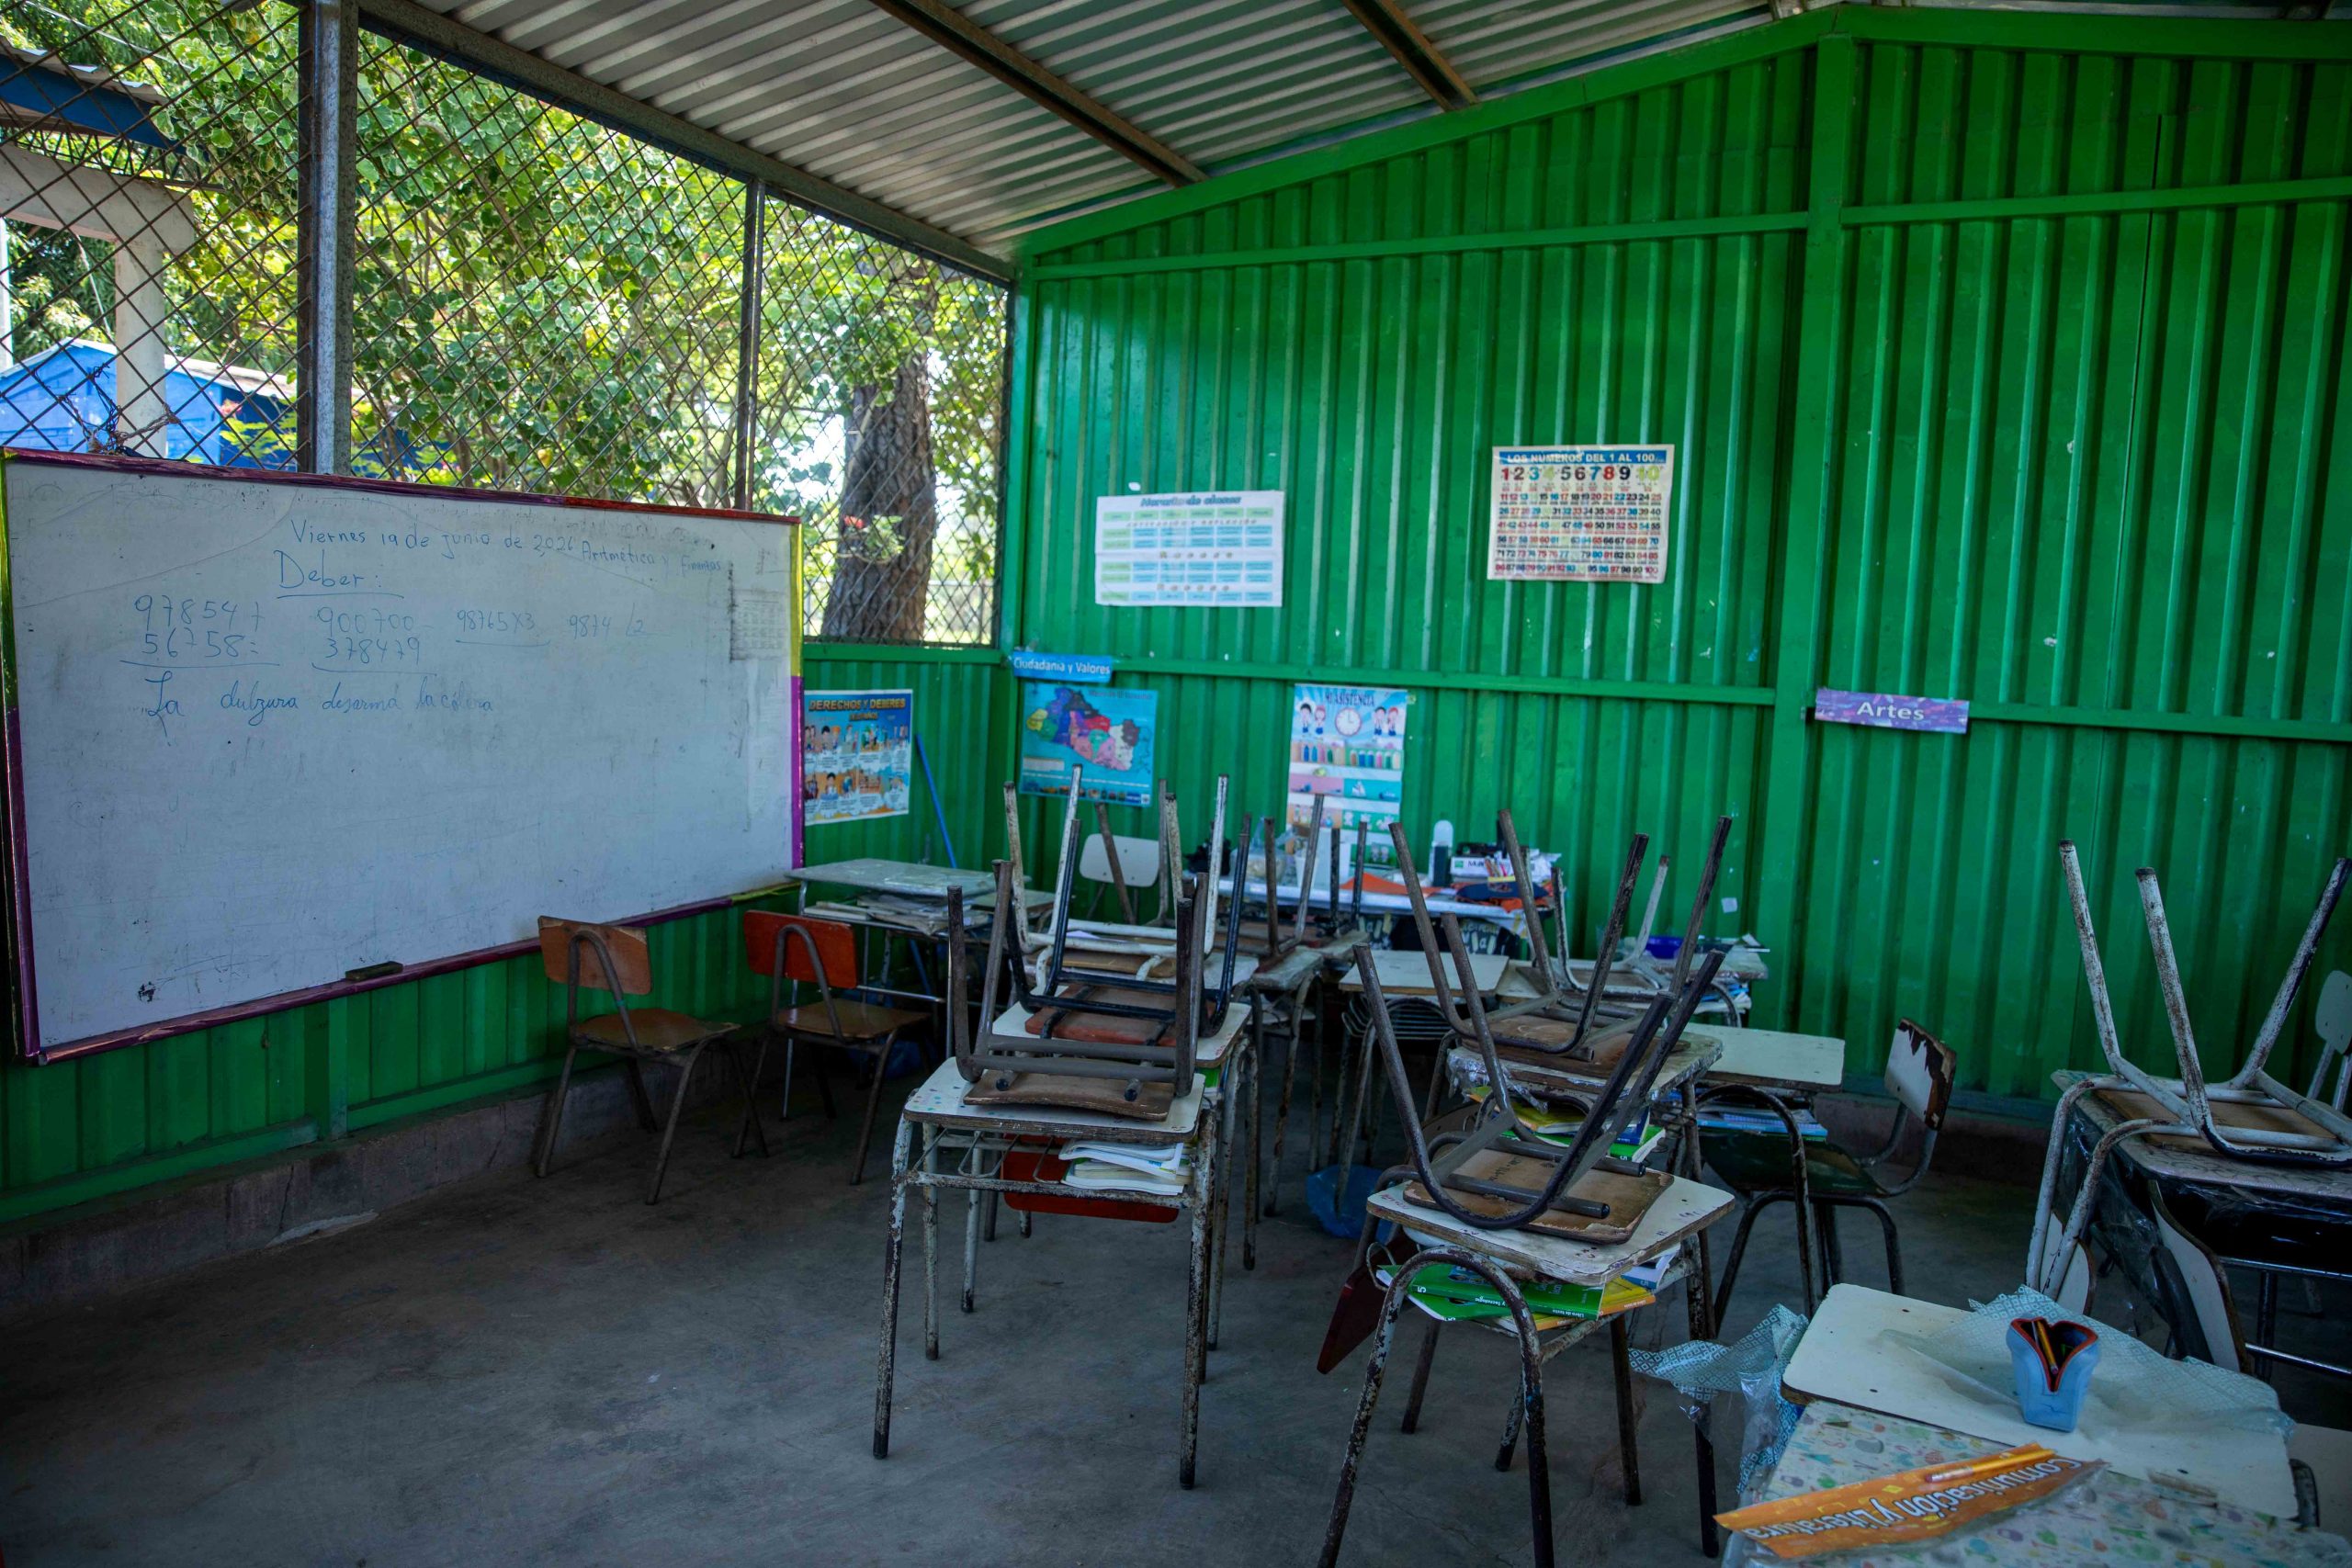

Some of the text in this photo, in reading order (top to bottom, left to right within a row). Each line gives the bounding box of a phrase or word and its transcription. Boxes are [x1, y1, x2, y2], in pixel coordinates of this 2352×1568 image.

[1586, 454, 1605, 462] DEL
[1609, 453, 1615, 462] 1
[1618, 453, 1632, 462] AL
[1635, 453, 1655, 462] 100
[1501, 468, 1510, 481] 1
[1513, 467, 1524, 480] 2
[1529, 467, 1540, 480] 3
[1560, 466, 1571, 480] 5
[1574, 466, 1586, 480] 6
[1589, 466, 1601, 480] 7
[1602, 465, 1615, 480] 8
[1619, 466, 1631, 480] 9
[290, 519, 367, 544] Viernes
[405, 520, 429, 549] de
[504, 524, 523, 549] de
[316, 606, 415, 637] 900700
[323, 637, 420, 665] 378479
[1068, 664, 1073, 674] y
[1075, 661, 1110, 674] Valores
[220, 680, 299, 726] dulzura
[1857, 701, 1925, 721] Artes
[1892, 1457, 2084, 1520] Comunicación
[1741, 1508, 1892, 1540] Literatura
